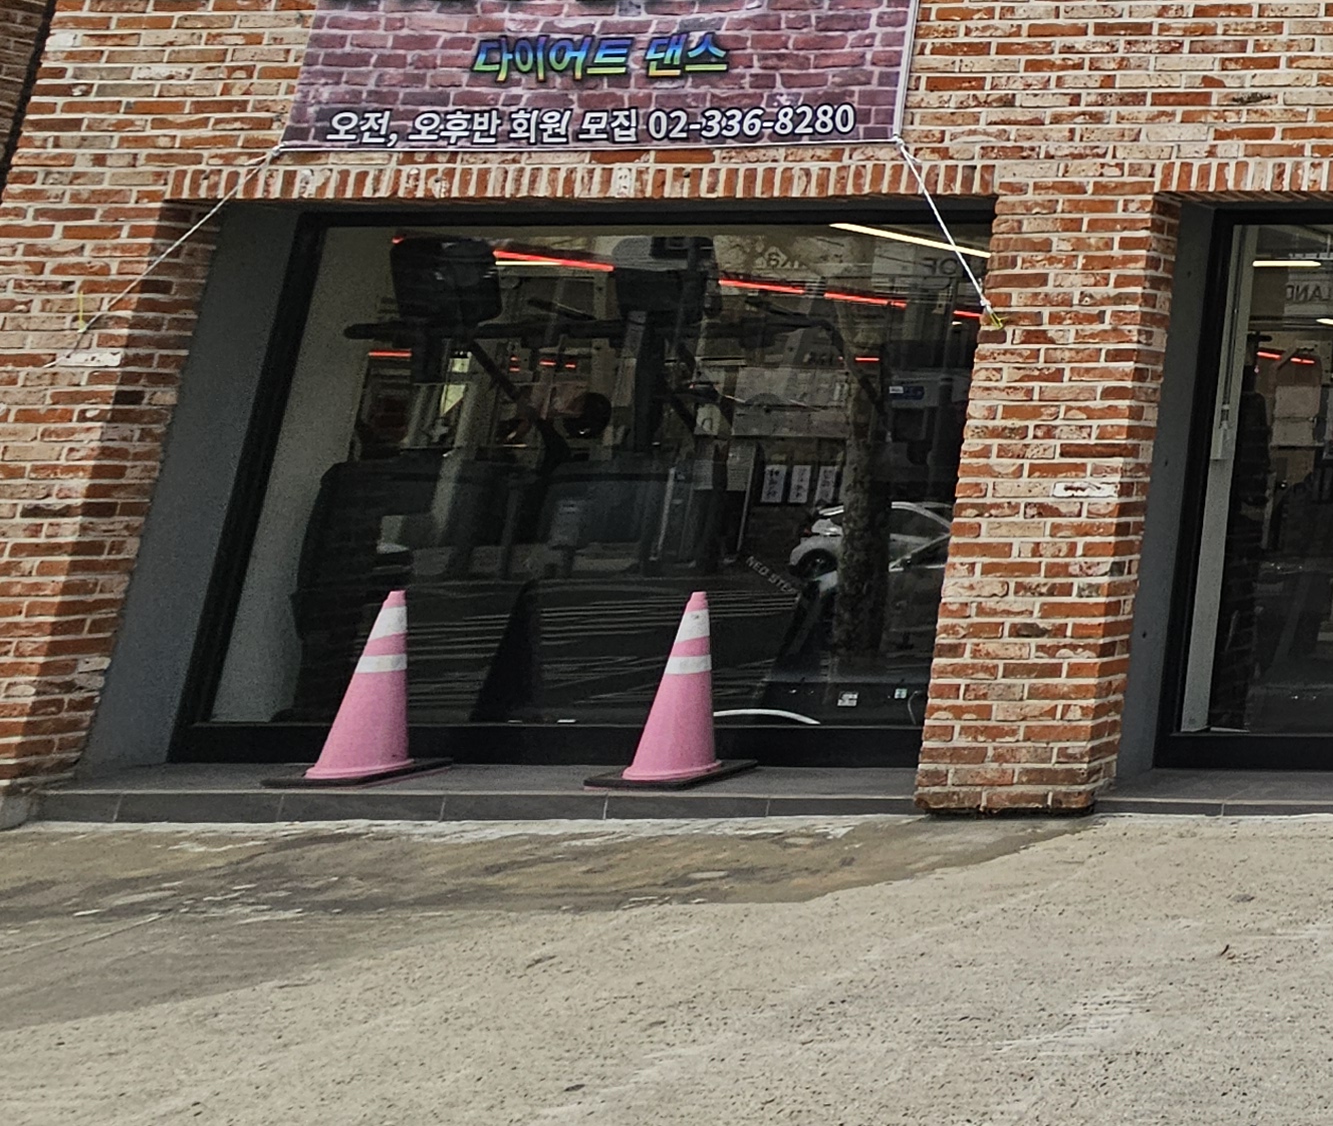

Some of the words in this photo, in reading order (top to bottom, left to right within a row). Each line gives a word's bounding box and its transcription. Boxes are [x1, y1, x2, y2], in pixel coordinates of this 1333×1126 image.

[471, 36, 631, 84] 다이어트
[644, 33, 728, 78] 댄스
[326, 111, 398, 147] 오전,
[407, 109, 503, 145] 오후반
[508, 109, 571, 143] 회원
[578, 108, 638, 142] 모집
[648, 104, 855, 141] 02-336-8280
